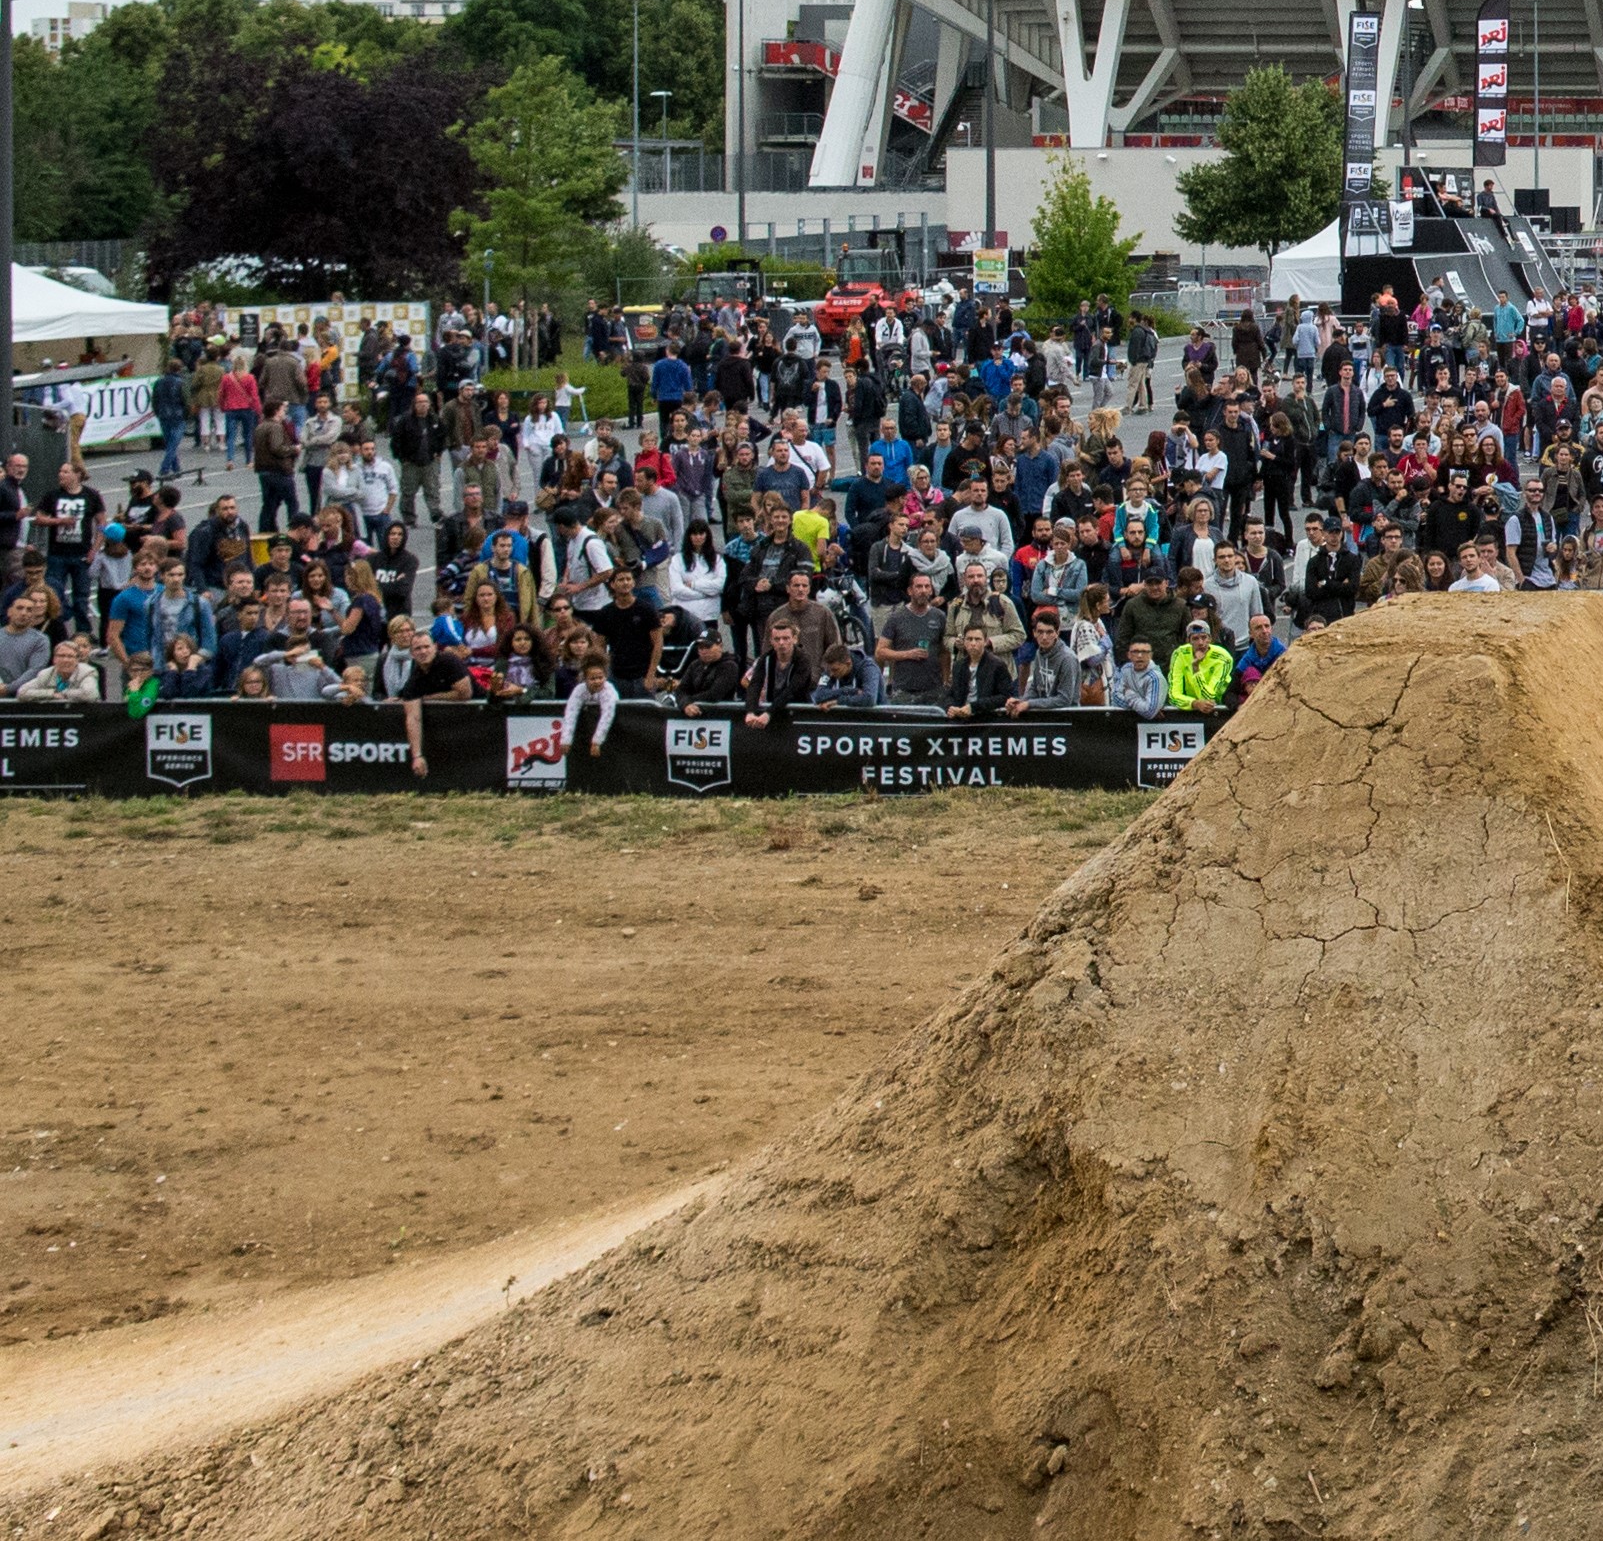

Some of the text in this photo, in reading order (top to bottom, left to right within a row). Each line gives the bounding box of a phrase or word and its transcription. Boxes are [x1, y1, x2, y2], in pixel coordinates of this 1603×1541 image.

[1356, 20, 1375, 30] FISE
[1353, 93, 1373, 103] FISE
[1350, 166, 1369, 176] FISE
[82, 384, 151, 419] JITO
[155, 721, 204, 745] FISE
[674, 726, 722, 750] FISE
[797, 735, 1068, 757] SPORTS XTREMES
[1146, 730, 1197, 753] FISE
[282, 741, 410, 763] SFR SPORT
[676, 760, 722, 768] XPERIENCE
[1146, 763, 1185, 771] XPERIEN
[685, 768, 715, 776] SERIES
[861, 765, 1003, 786] FESTIVAL
[1155, 771, 1178, 779] SERI
